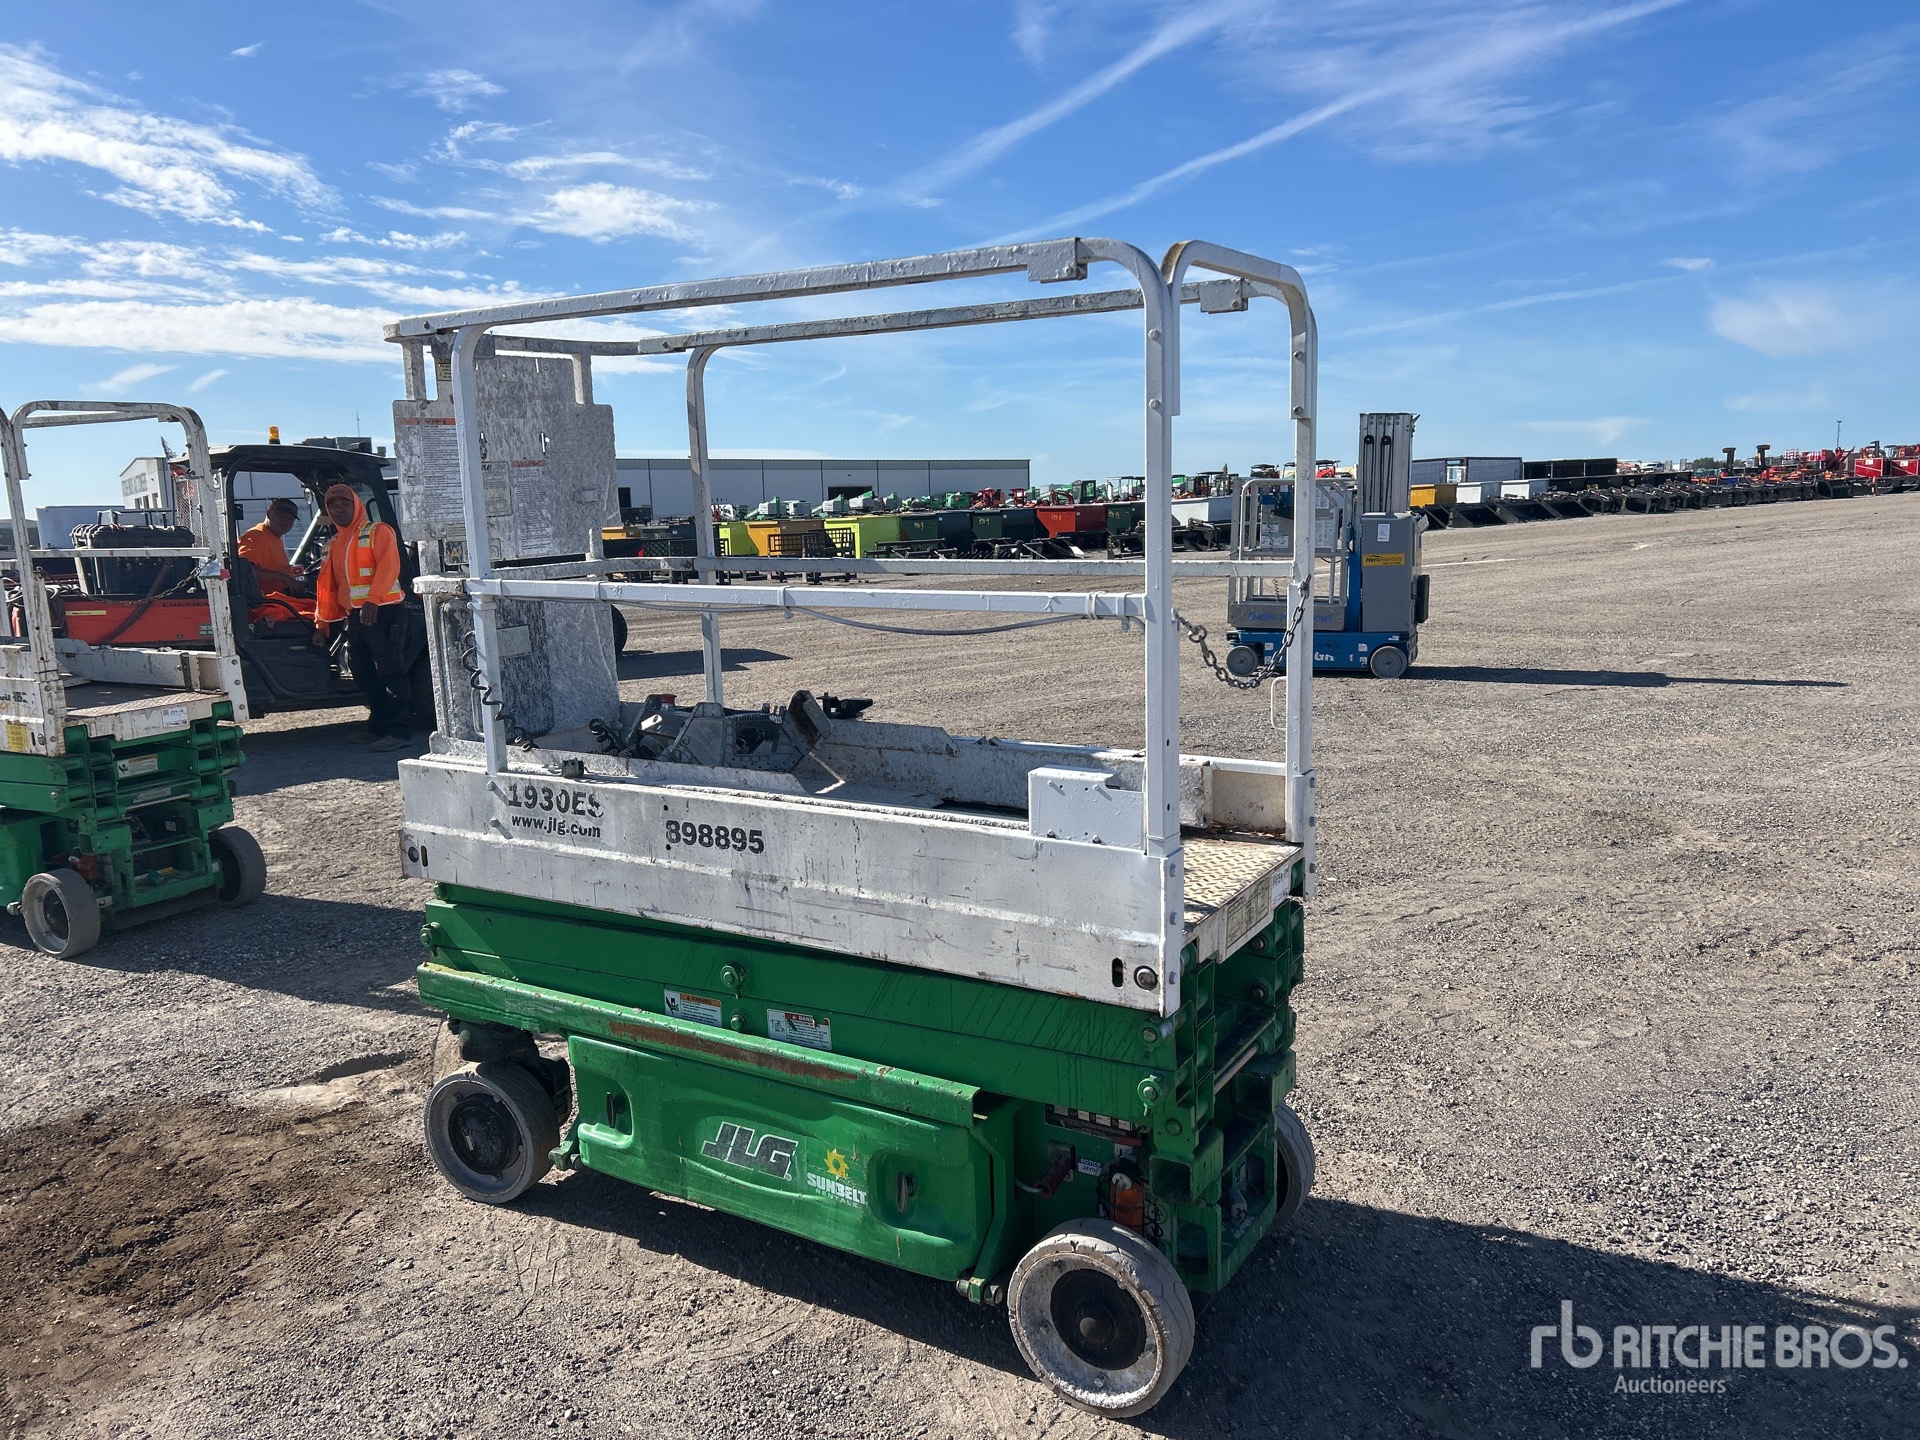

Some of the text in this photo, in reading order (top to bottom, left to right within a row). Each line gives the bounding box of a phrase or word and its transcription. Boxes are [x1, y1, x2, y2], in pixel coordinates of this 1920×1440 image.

[508, 782, 603, 818] 1930ES
[512, 813, 600, 838] www.jlg.com
[665, 819, 765, 854] 898895
[700, 1121, 798, 1180] JLG
[806, 1172, 867, 1205] SUNBELT
